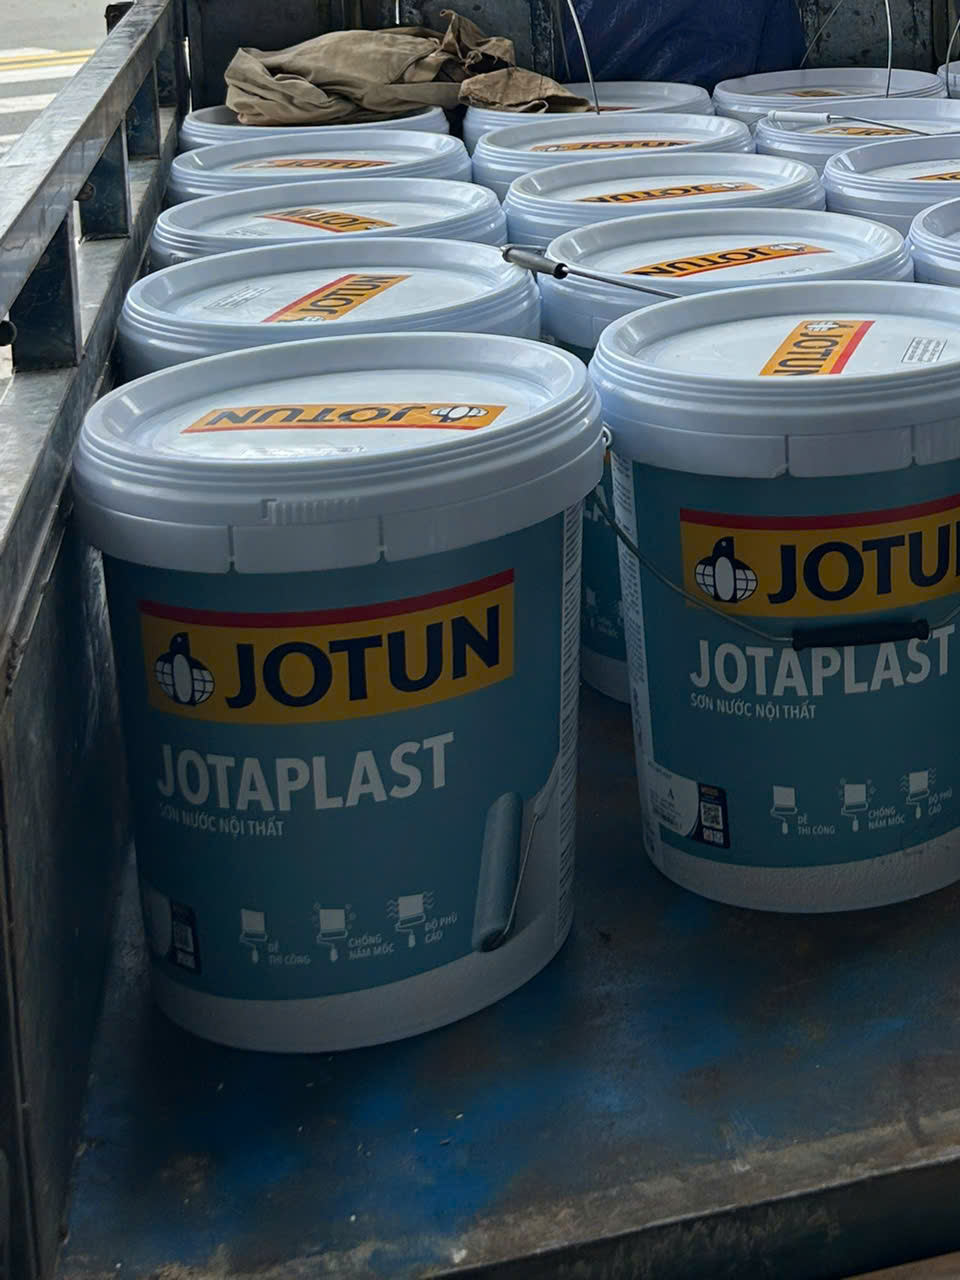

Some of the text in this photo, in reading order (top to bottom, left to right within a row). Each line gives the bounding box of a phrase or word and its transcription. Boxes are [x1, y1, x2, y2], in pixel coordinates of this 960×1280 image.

[632, 247, 771, 277] JOTUN
[298, 274, 400, 315] JOTUN
[204, 405, 426, 426] JOTUN
[225, 604, 501, 708] JOTUN
[690, 623, 955, 697] JOTAPLAST
[691, 693, 816, 721] SƠN NƯỚC NỘI THẤT
[156, 731, 454, 812] JOTAPLAST
[182, 809, 217, 833] NƯỚC
[219, 814, 245, 839] NỘI
[247, 815, 284, 837] THẤT
